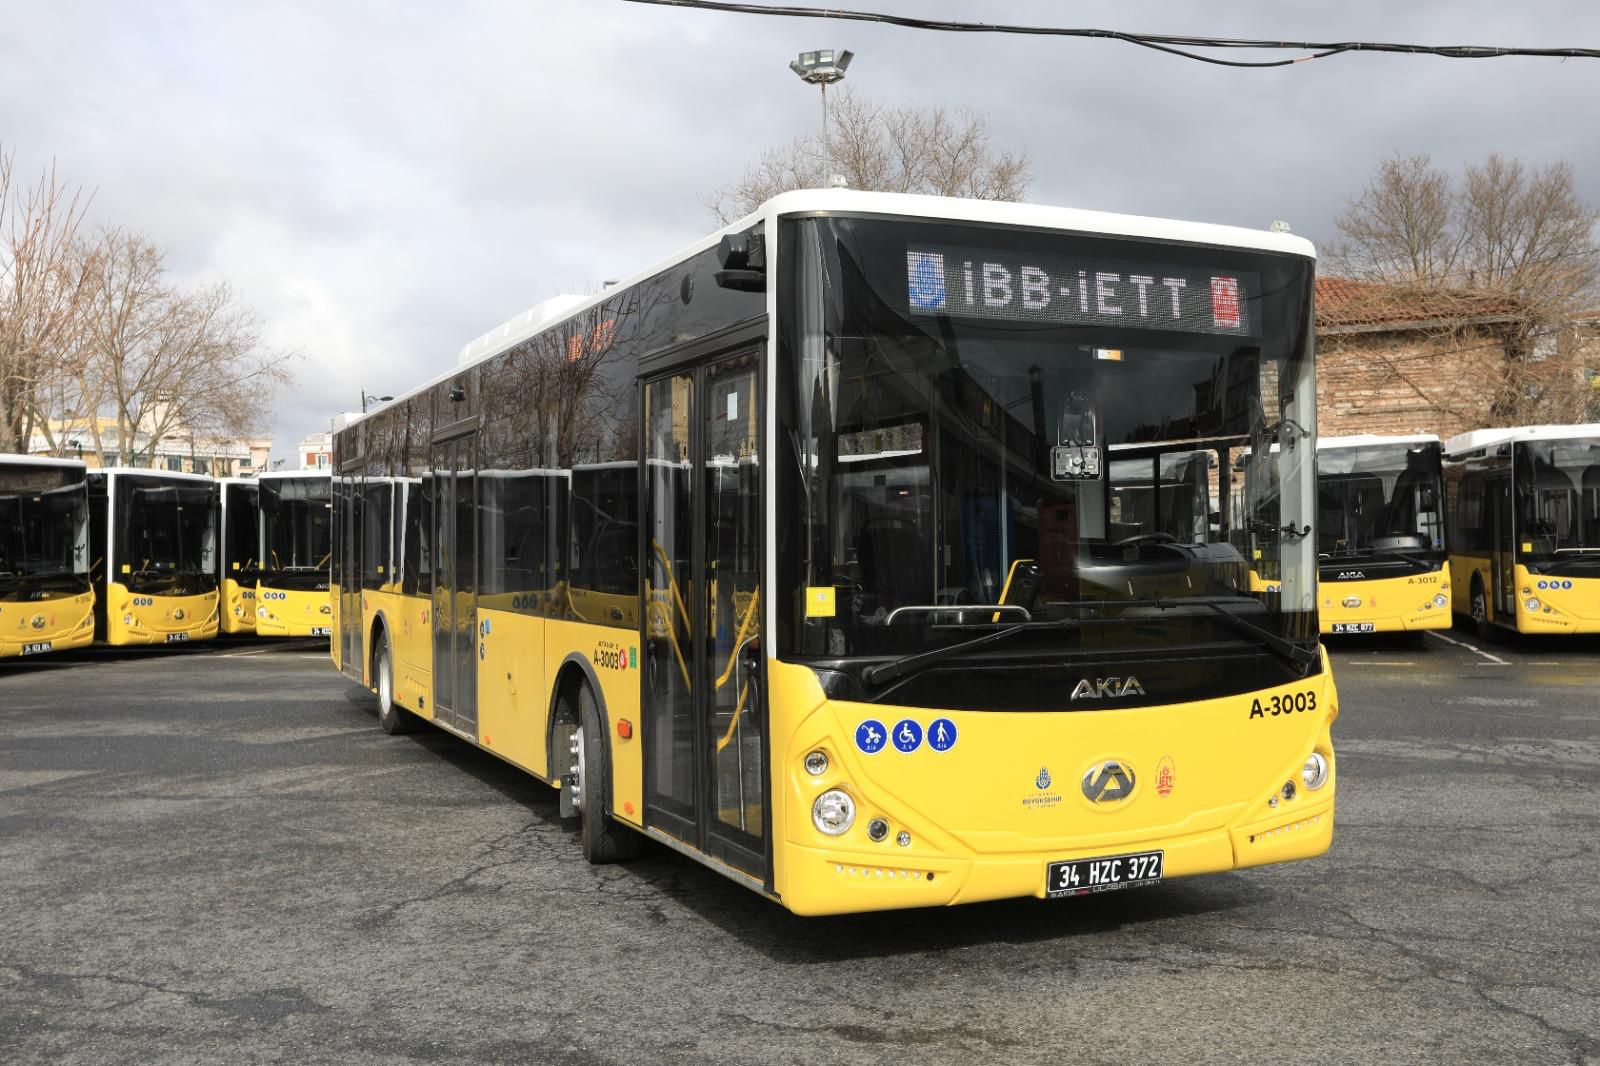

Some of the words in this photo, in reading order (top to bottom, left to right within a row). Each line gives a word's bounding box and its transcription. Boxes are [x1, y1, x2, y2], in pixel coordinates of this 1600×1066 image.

[1337, 571, 1366, 580] AKIA
[1407, 576, 1438, 586] A-3012
[1335, 624, 1344, 632] 34
[593, 648, 619, 670] A-3003
[1070, 676, 1147, 701] AKIA
[1249, 690, 1318, 720] A-3003
[1059, 864, 1080, 888] 34
[1089, 859, 1122, 885] HZC
[1127, 854, 1160, 880] 372
